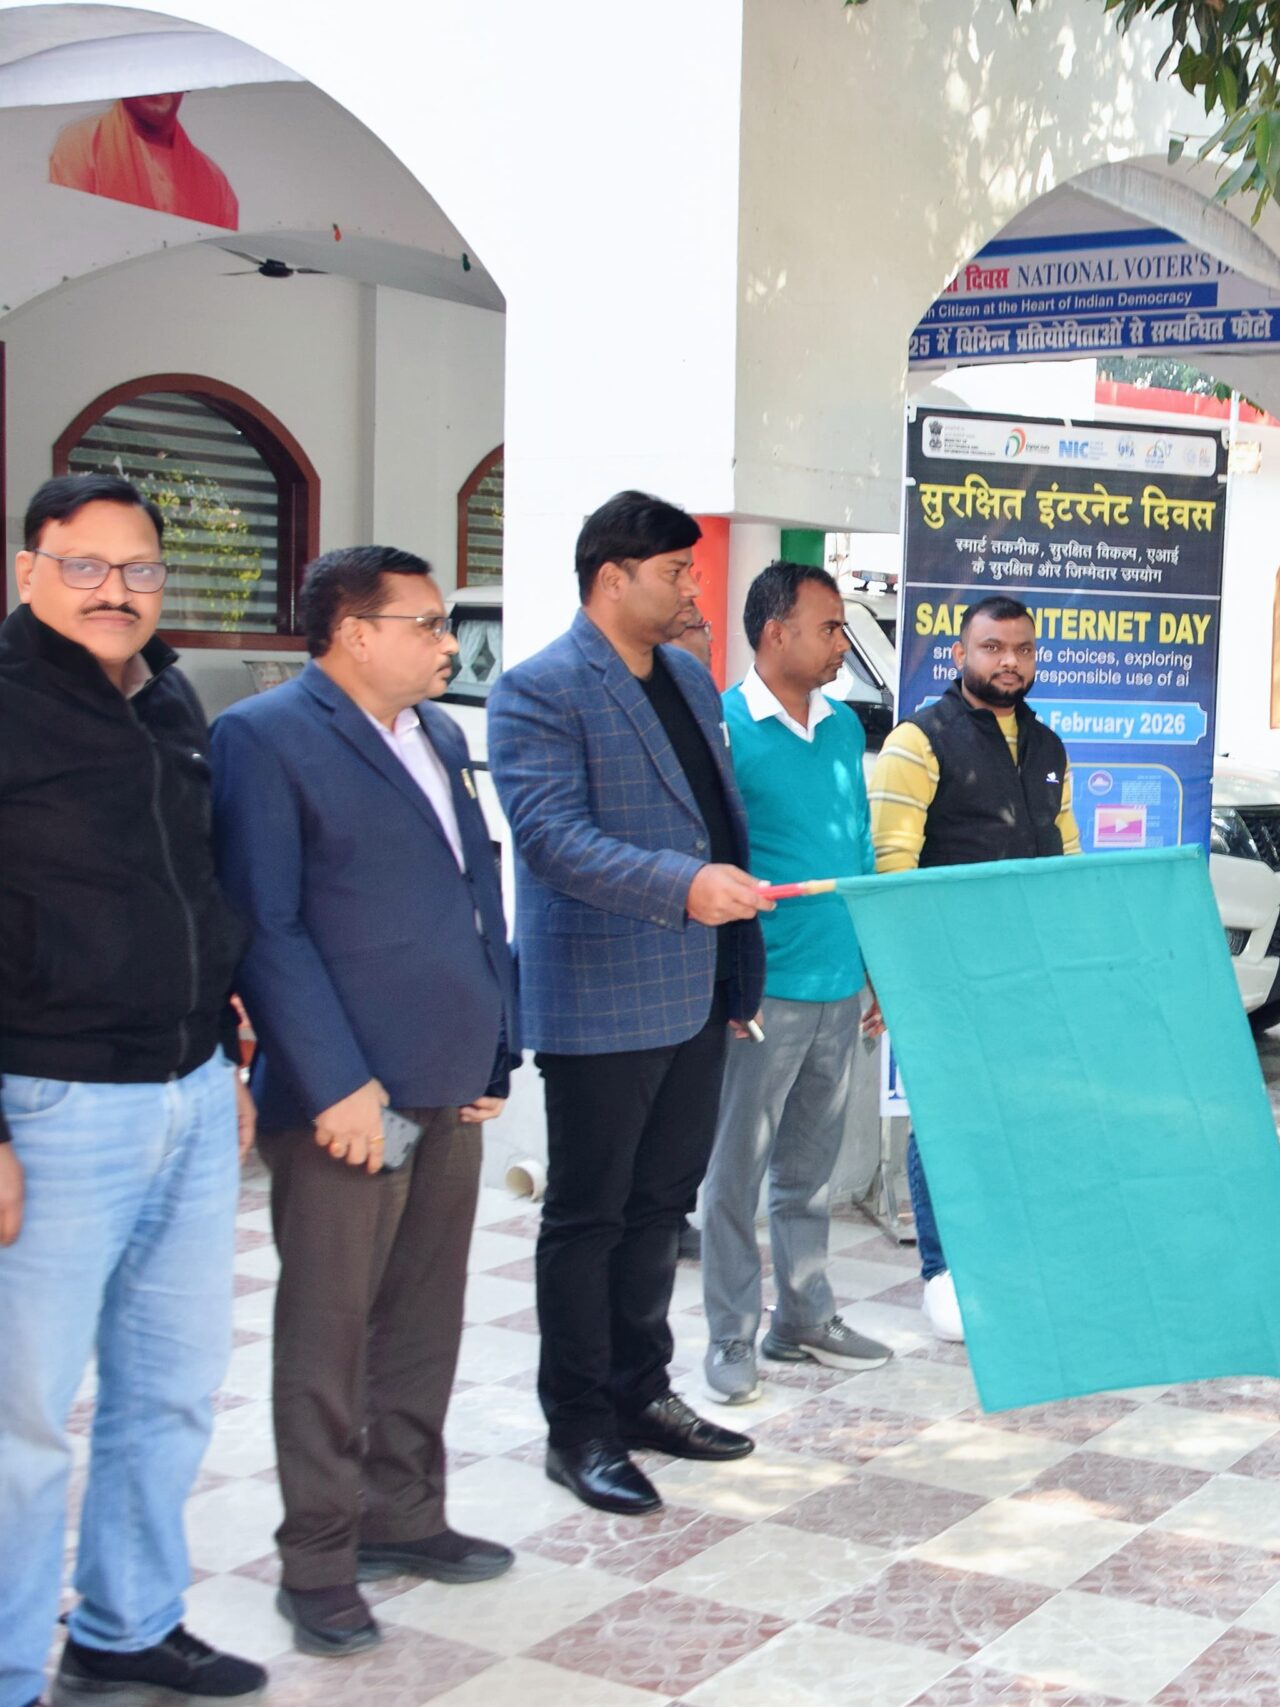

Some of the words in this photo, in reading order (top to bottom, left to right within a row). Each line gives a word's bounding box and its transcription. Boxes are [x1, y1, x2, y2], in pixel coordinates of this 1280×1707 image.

[965, 264, 1010, 291] दिवस
[1017, 259, 1118, 289] NATIONAL
[1124, 252, 1211, 281] VOTER'S
[939, 301, 980, 319] Citizen
[984, 302, 996, 315] at
[998, 299, 1018, 314] the
[1021, 297, 1055, 313] Heart
[1058, 295, 1072, 310] of
[1075, 294, 1114, 309] Indian
[1118, 291, 1193, 307] Democracy
[936, 326, 952, 355] में
[1129, 316, 1145, 345] से
[1231, 310, 1273, 339] फोटो
[1058, 440, 1089, 459] NIC
[919, 473, 1026, 529] सुरक्षित
[1036, 482, 1133, 530] इंटरनेट
[1141, 485, 1216, 532] दिवस
[955, 535, 987, 553] स्मार्ट
[1049, 539, 1093, 562] सुरक्षित
[1146, 545, 1180, 566] एआई
[971, 556, 986, 575] के
[989, 558, 1034, 580] सुरक्षित
[1037, 559, 1062, 578] और
[1065, 561, 1118, 580] जिम्मेदार
[1121, 565, 1163, 583] उपयोग
[915, 603, 969, 636] SAF
[1026, 607, 1151, 643] NTERNET
[1159, 612, 1211, 646] DAY
[1057, 648, 1120, 667] choices,
[1124, 651, 1193, 671] exploring
[933, 664, 957, 681] the
[1034, 668, 1122, 687] responsible
[1126, 674, 1154, 686] use
[1157, 671, 1173, 686] of
[1176, 671, 1190, 687] ai
[1050, 711, 1135, 739] February
[1139, 712, 1186, 735] 2026
